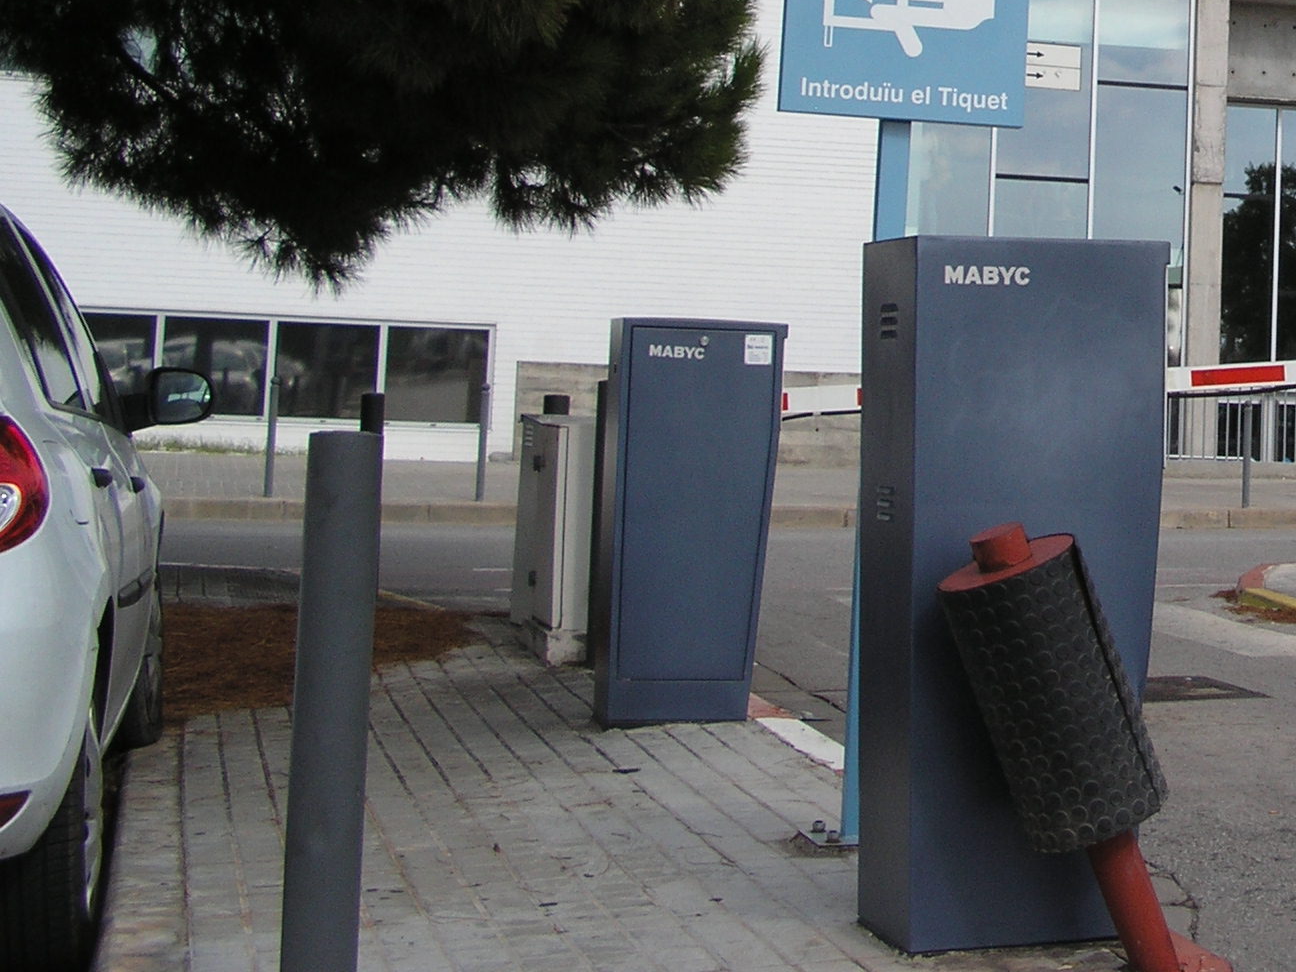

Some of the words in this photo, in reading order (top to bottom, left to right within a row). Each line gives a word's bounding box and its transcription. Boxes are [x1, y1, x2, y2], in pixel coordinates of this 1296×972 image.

[801, 77, 904, 103] Introduïu
[911, 86, 930, 105] el
[938, 86, 1009, 113] Tiquet
[944, 265, 1031, 286] MABYC
[648, 344, 705, 360] MABYC
